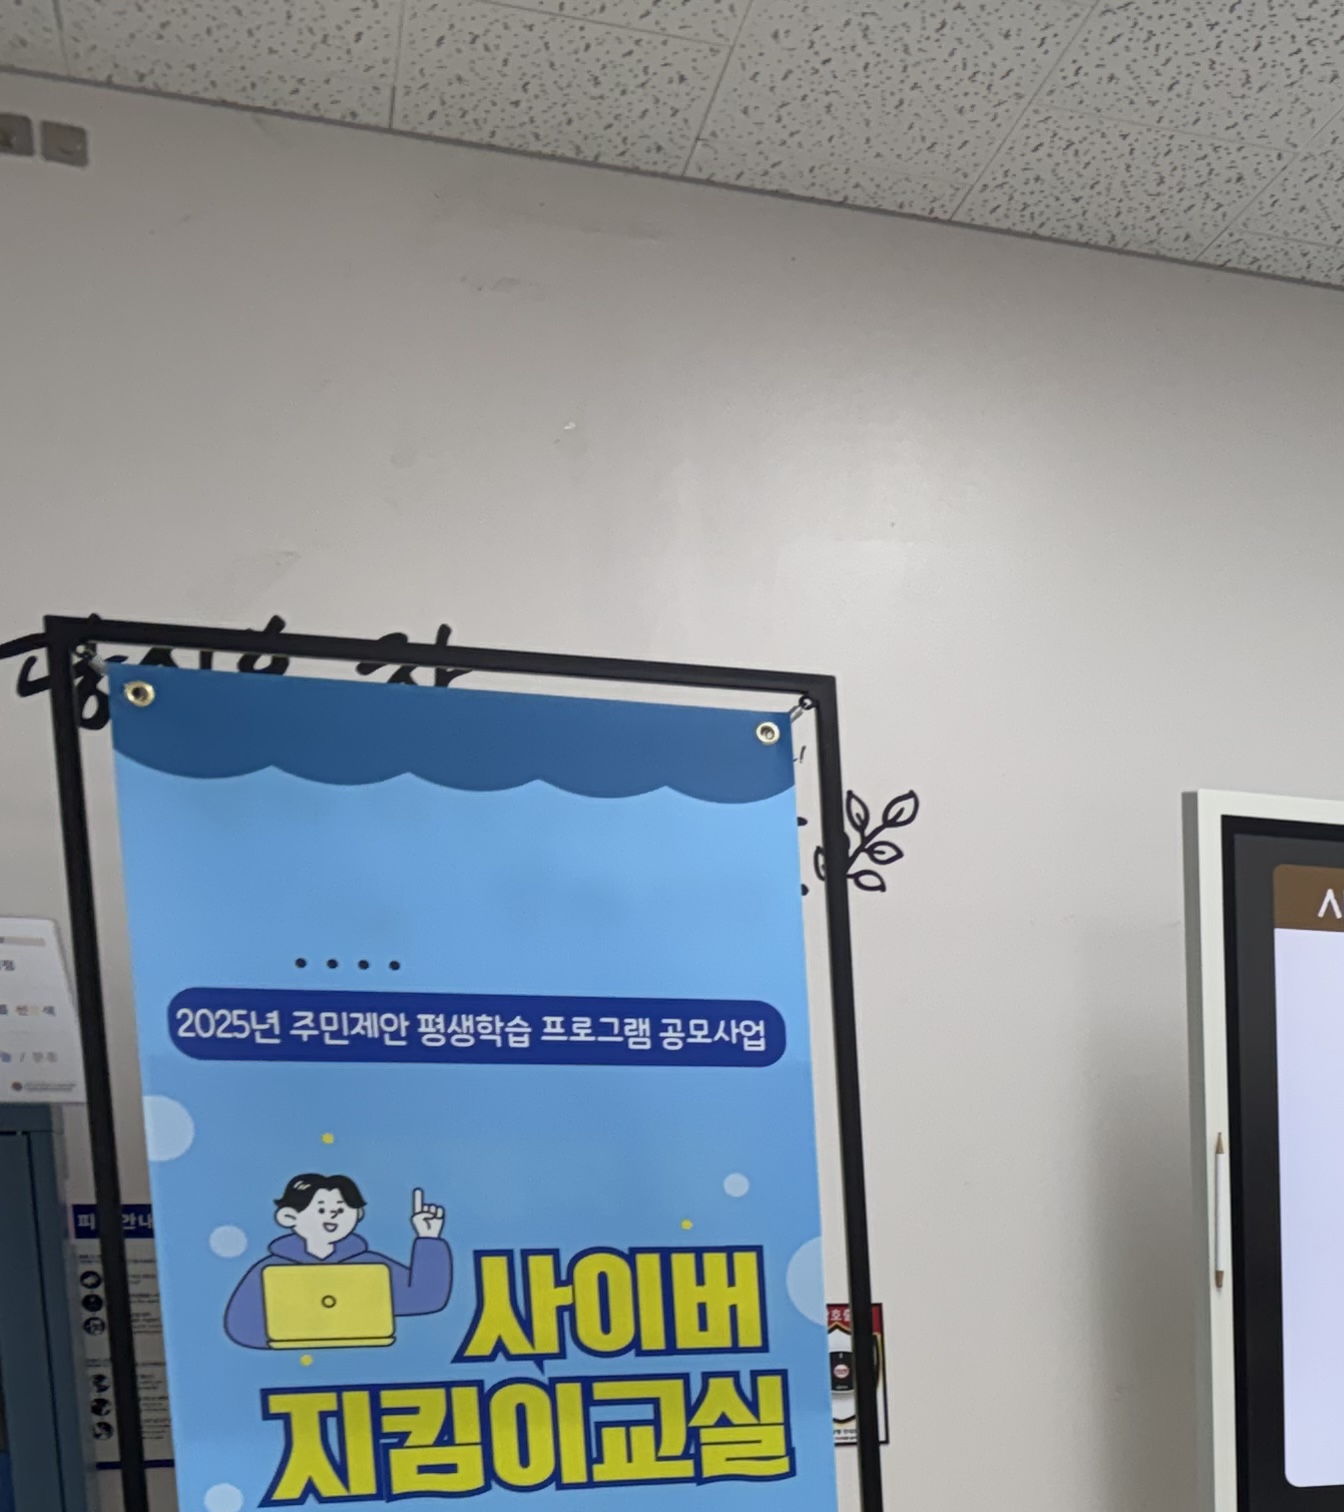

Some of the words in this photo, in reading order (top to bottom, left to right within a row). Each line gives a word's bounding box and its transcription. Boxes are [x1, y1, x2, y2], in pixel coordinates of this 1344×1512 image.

[176, 1008, 281, 1044] 2025년
[289, 1011, 410, 1046] 주민제안
[417, 1014, 532, 1048] 평생학습
[541, 1017, 652, 1049] 프로그램
[659, 1018, 767, 1052] 공모사업
[453, 1245, 769, 1372] 사이버
[258, 1369, 796, 1508] 지킴이교실
